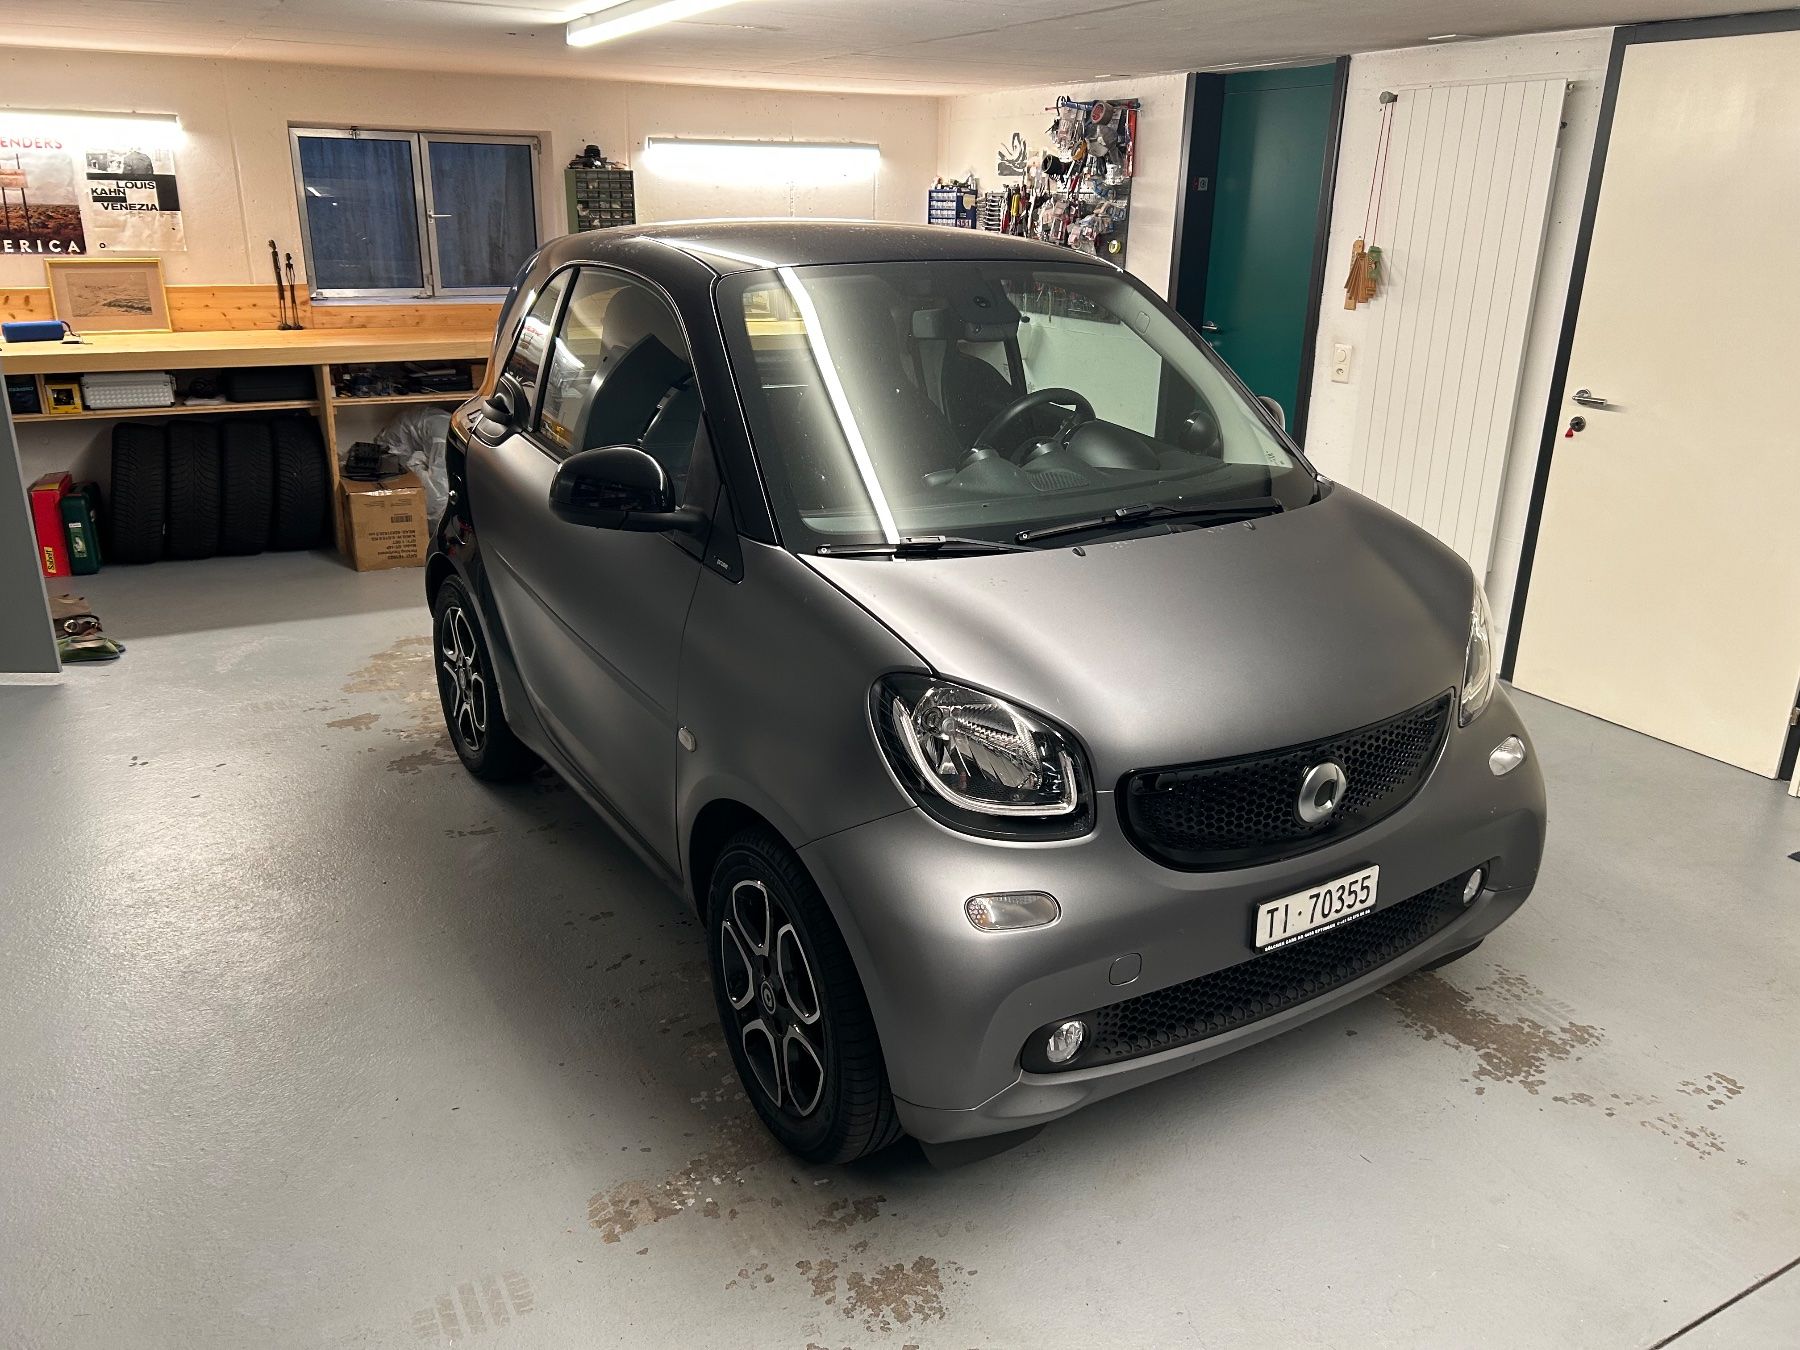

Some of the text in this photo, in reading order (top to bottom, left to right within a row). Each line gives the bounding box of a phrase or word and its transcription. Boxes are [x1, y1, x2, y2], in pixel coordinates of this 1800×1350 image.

[116, 181, 155, 190] LOUIS
[90, 187, 126, 196] KAHN
[101, 202, 159, 211] VENEZIA
[3, 239, 81, 253] ERICA
[1266, 875, 1371, 938] TI 70355
